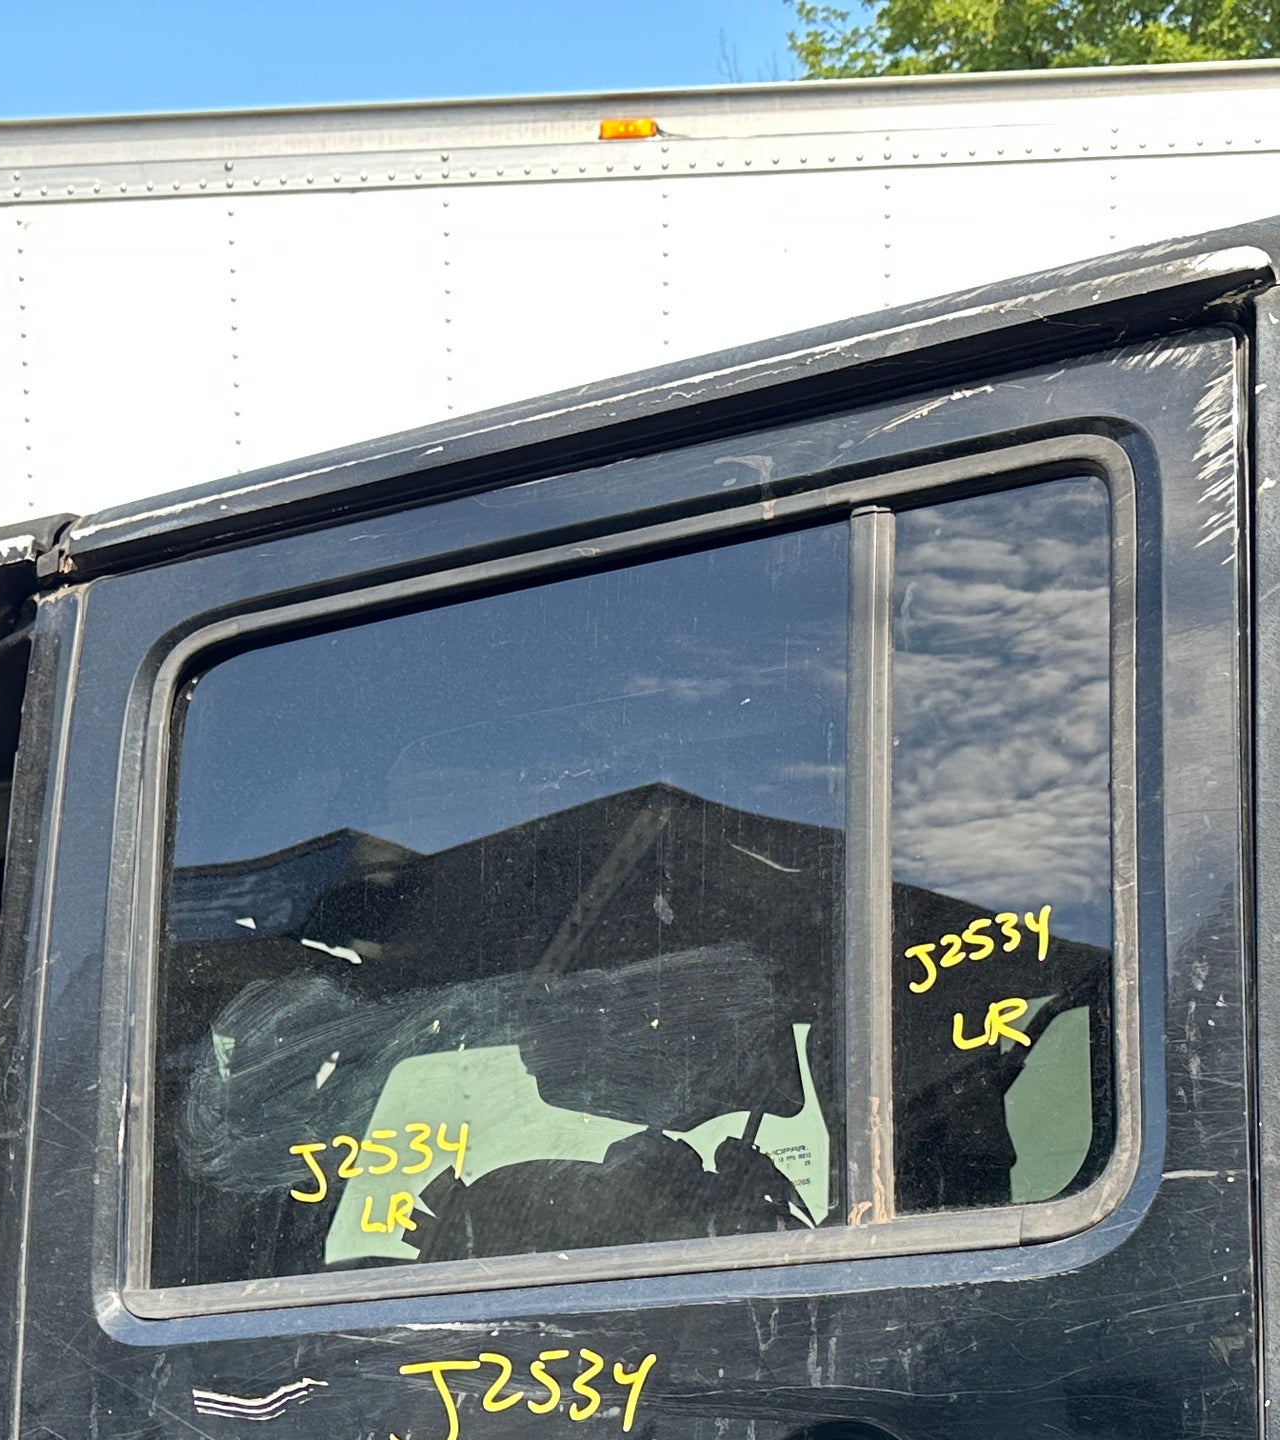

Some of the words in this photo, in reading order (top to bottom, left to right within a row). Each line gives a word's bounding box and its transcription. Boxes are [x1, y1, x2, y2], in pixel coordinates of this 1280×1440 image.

[904, 904, 1052, 994] J2534
[952, 997, 1031, 1050] LR
[289, 1122, 468, 1203] J2534
[360, 1191, 417, 1233] LR
